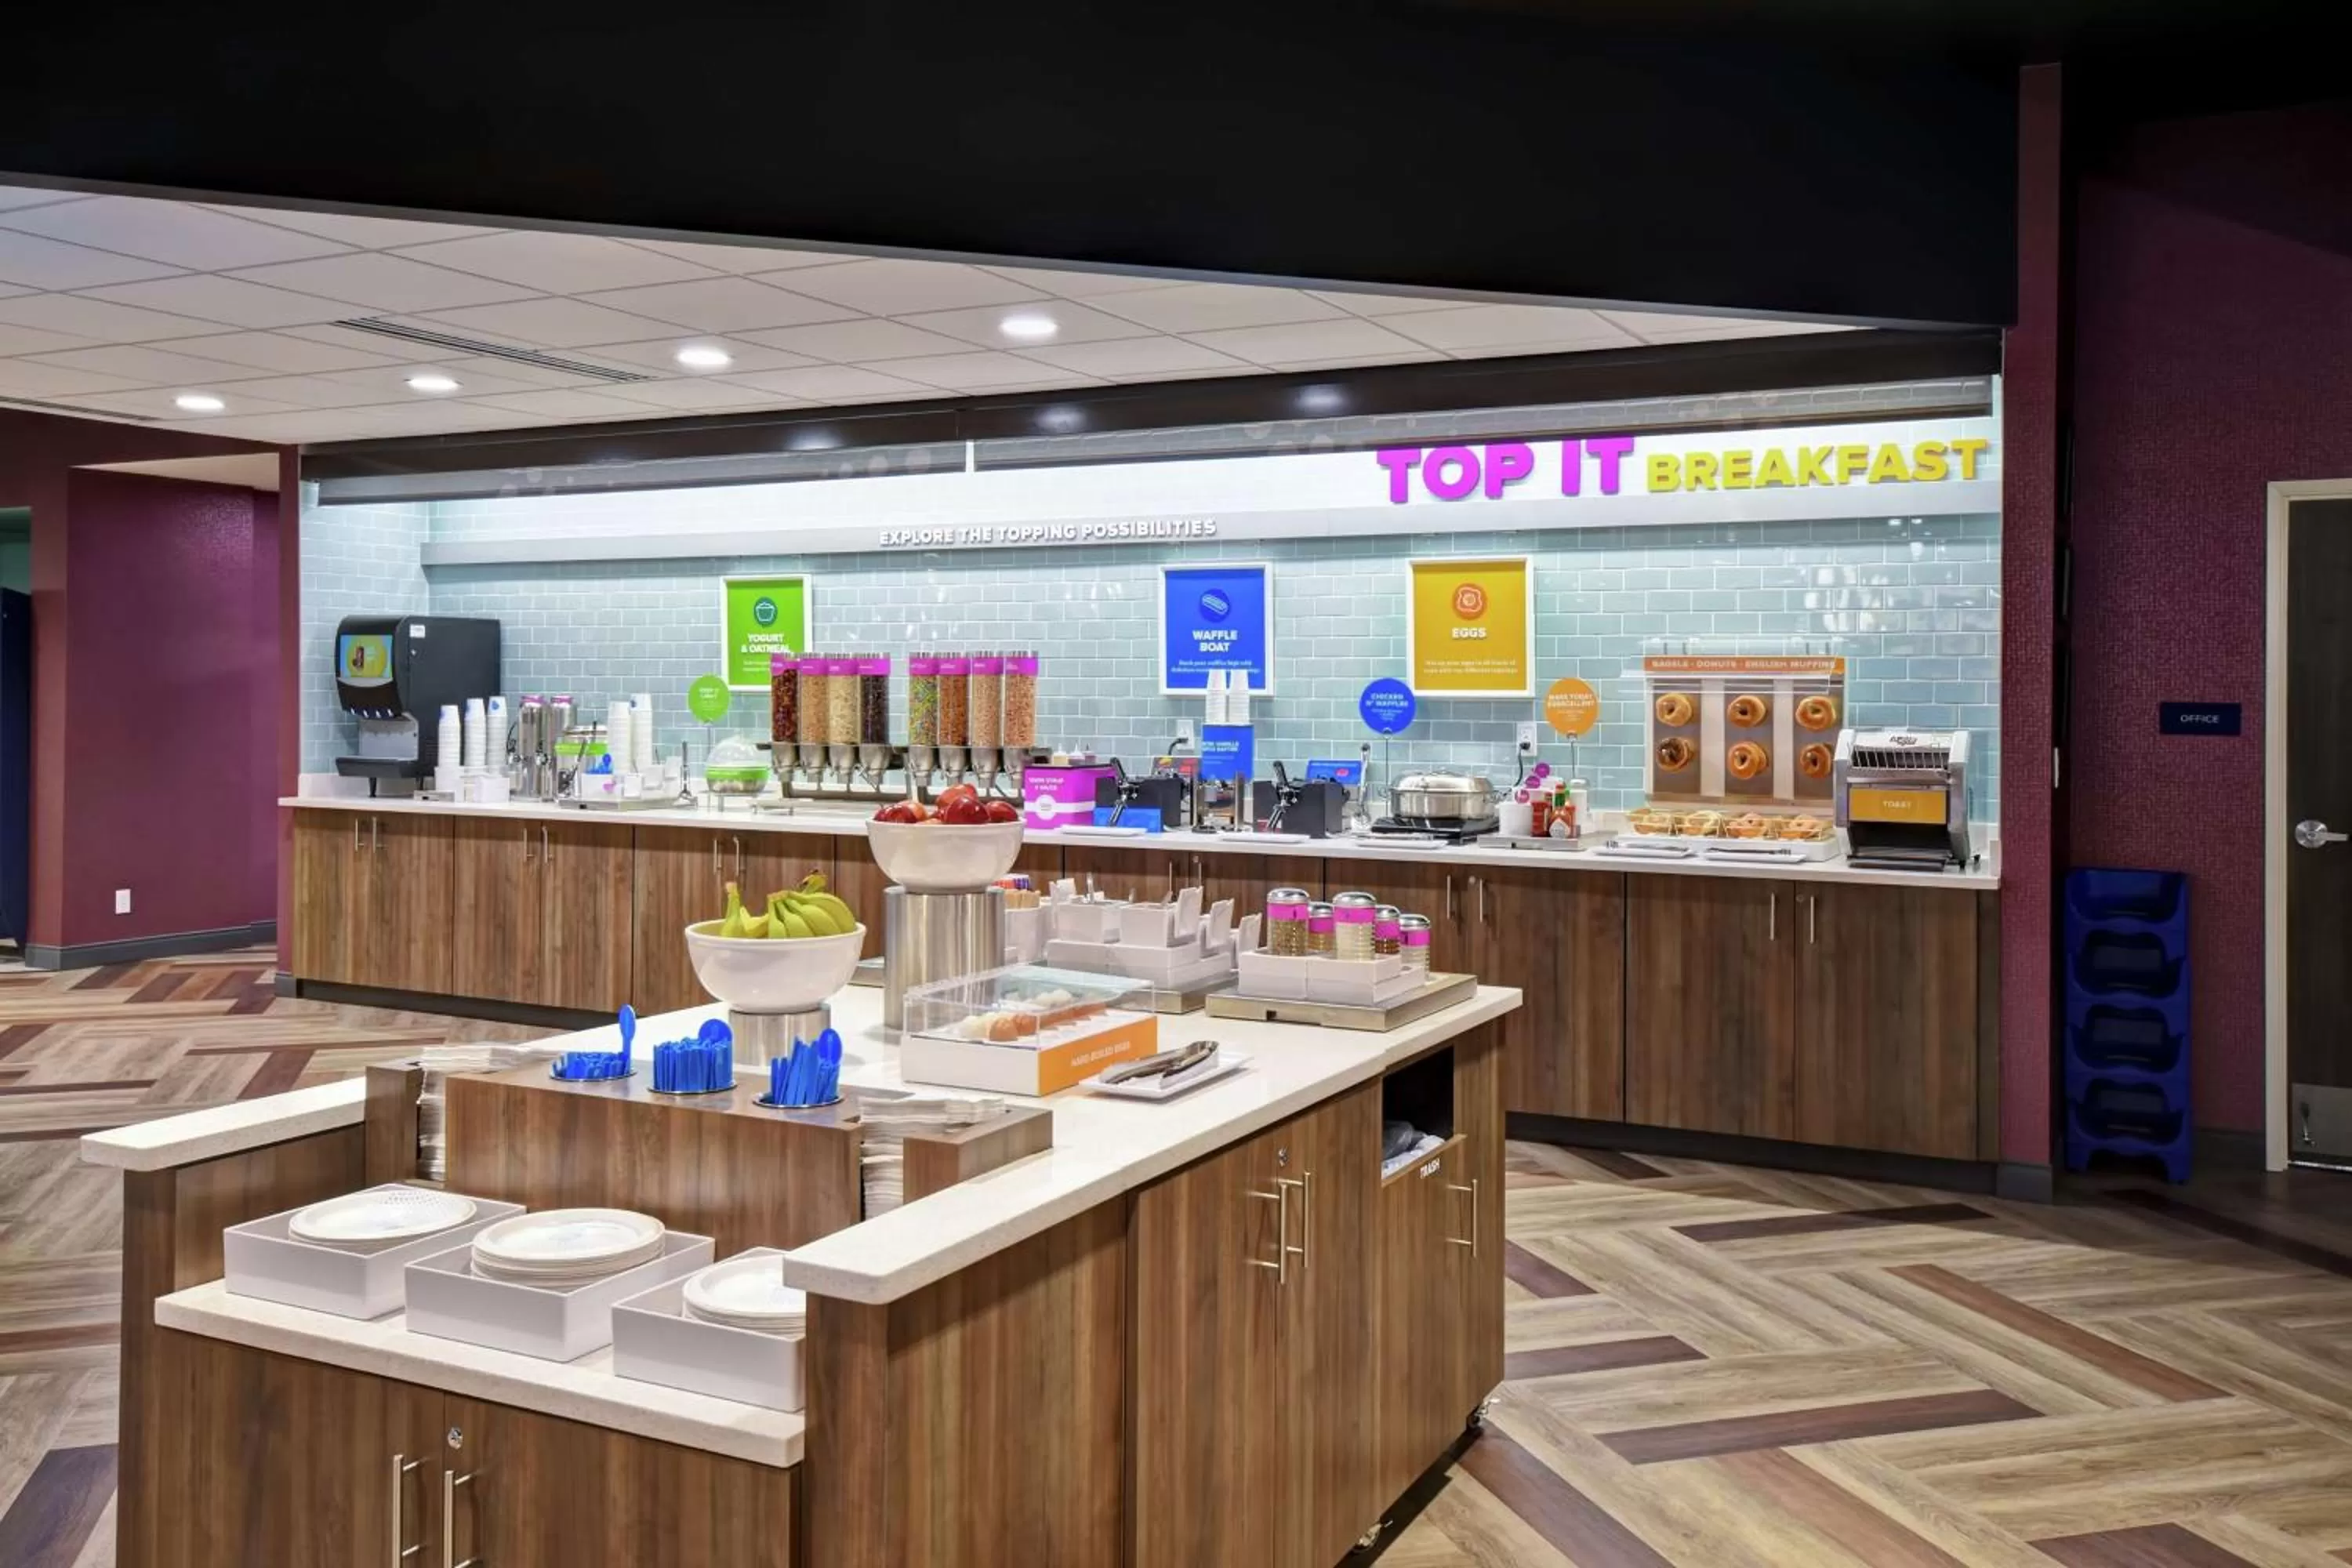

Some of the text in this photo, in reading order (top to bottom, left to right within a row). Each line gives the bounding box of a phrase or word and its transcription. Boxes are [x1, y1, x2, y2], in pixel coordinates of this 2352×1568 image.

[1377, 435, 1988, 503] TOP IT BREAKFAST
[880, 520, 1216, 546] EXPLORE THE TOPPING POSSIBILITIES
[748, 633, 784, 642] YOGURT
[1192, 630, 1238, 641] WAFFLE
[1452, 627, 1486, 639] EGGS
[1200, 642, 1230, 652] BOAT
[2180, 714, 2220, 723] OFFICE
[1882, 800, 1912, 809] TOAST
